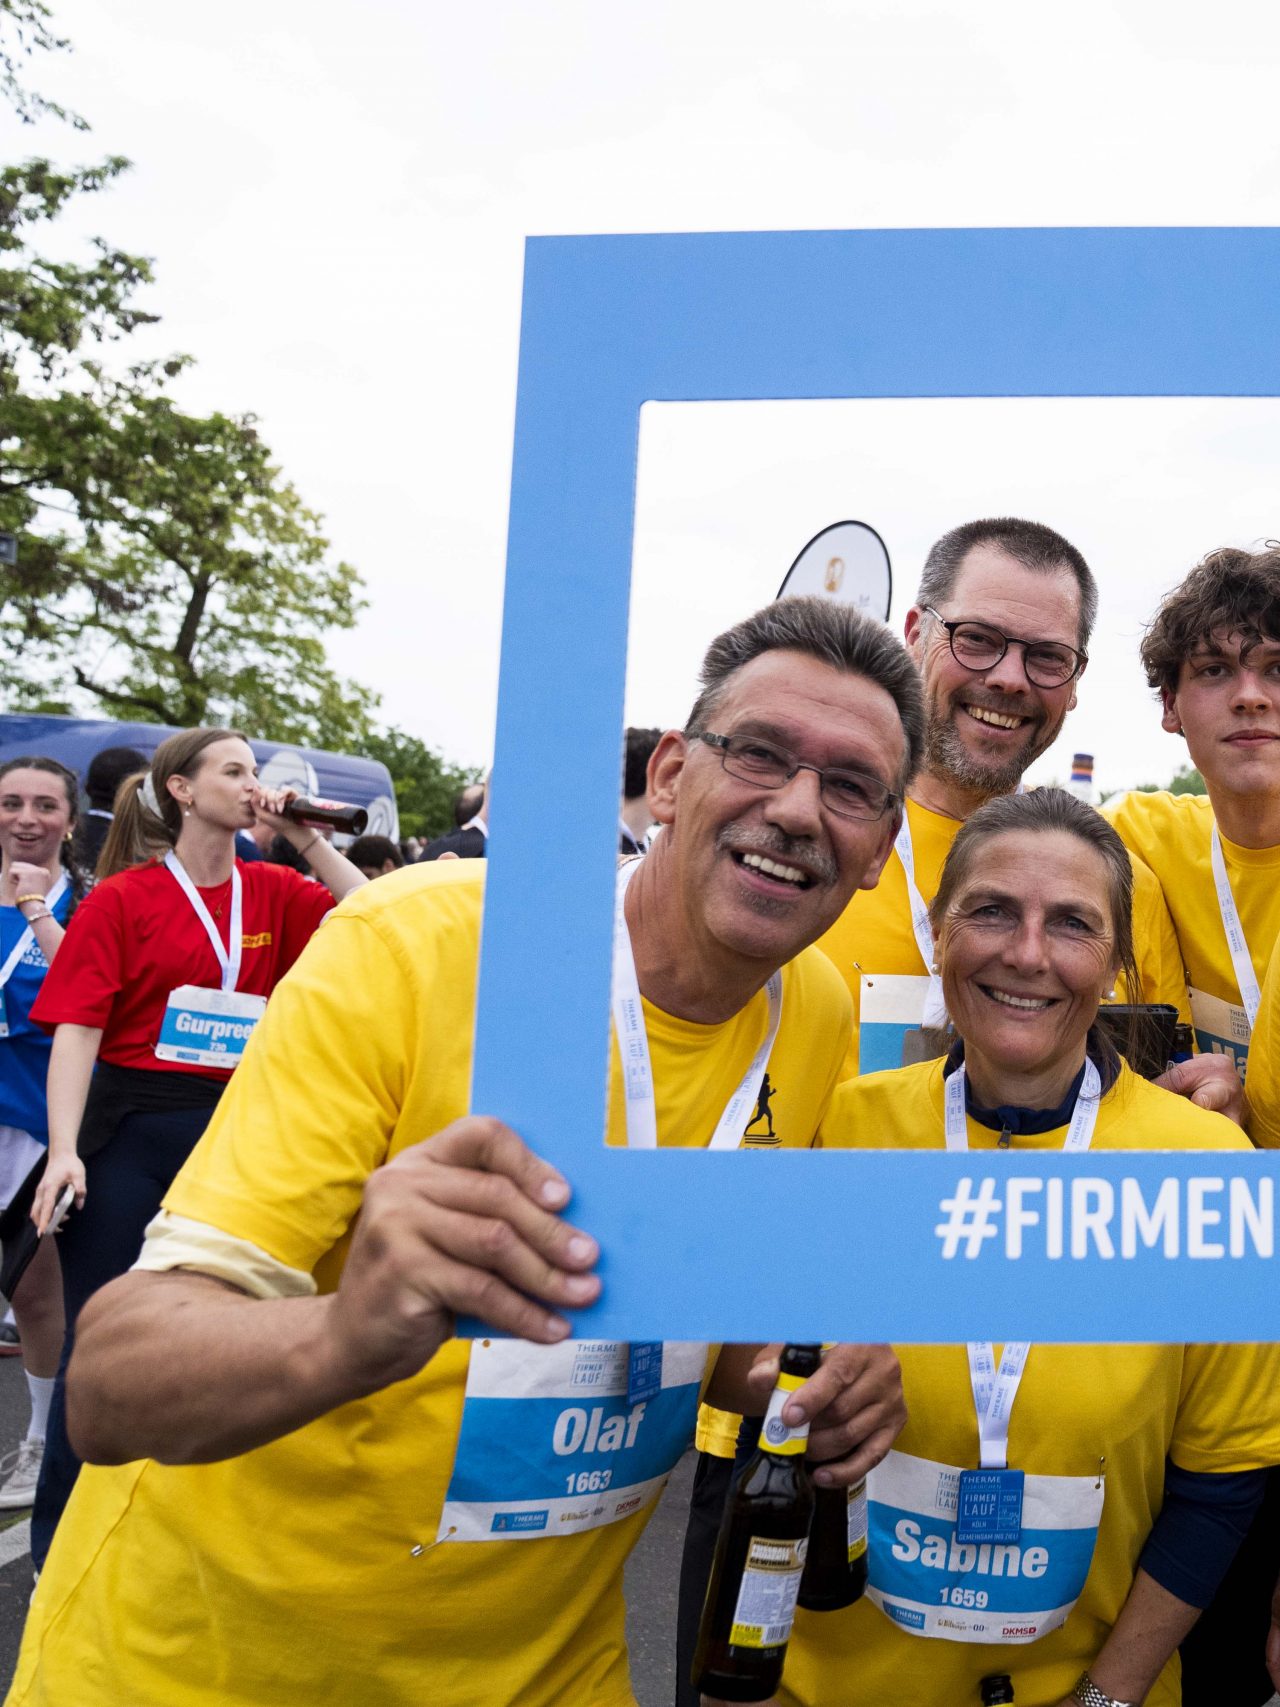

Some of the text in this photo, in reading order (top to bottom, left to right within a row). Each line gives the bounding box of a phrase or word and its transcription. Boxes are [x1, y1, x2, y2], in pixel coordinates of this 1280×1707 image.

[628, 998, 638, 1032] THERME
[175, 1012, 255, 1041] Gurpree
[577, 1343, 617, 1353] THERME
[574, 1372, 600, 1384] LAUF
[552, 1402, 647, 1456] Olaf
[566, 1470, 612, 1495] 1663
[963, 1476, 1000, 1484] THERME
[965, 1494, 996, 1503] FIRMEN
[964, 1503, 996, 1516] LAUF
[892, 1518, 1049, 1579] Sabine
[940, 1587, 989, 1609] 1659
[1002, 1627, 1029, 1635] DKMS
